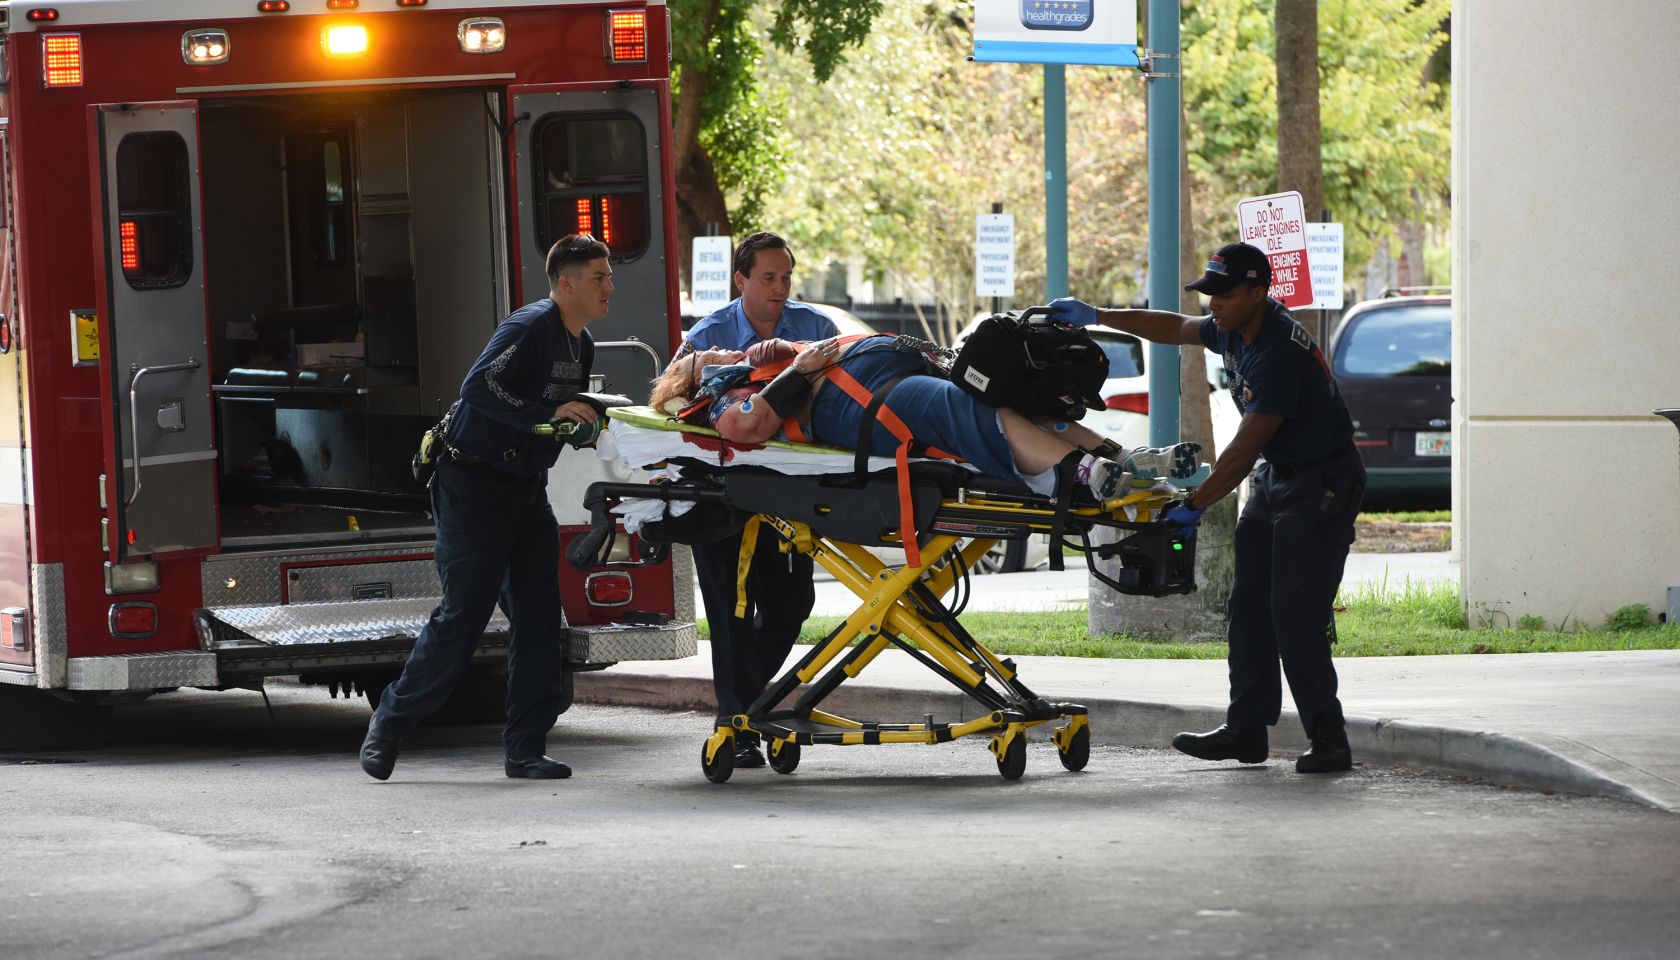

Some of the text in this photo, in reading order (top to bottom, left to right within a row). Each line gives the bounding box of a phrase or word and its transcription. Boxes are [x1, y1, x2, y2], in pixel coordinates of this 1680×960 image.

[1026, 10, 1087, 24] healthgrades
[1256, 207, 1284, 224] DO NOT
[980, 225, 1009, 233] EMERGENCY
[1245, 219, 1300, 240] LEAVE ENGINES
[1266, 237, 1283, 251] IDLE
[1309, 246, 1340, 254] EPARTMENT
[700, 252, 723, 262] DETAIL
[1272, 252, 1301, 269] ENGINES
[696, 271, 726, 281] OFFICER
[1275, 267, 1299, 283] WHILE
[695, 290, 726, 300] PARKING
